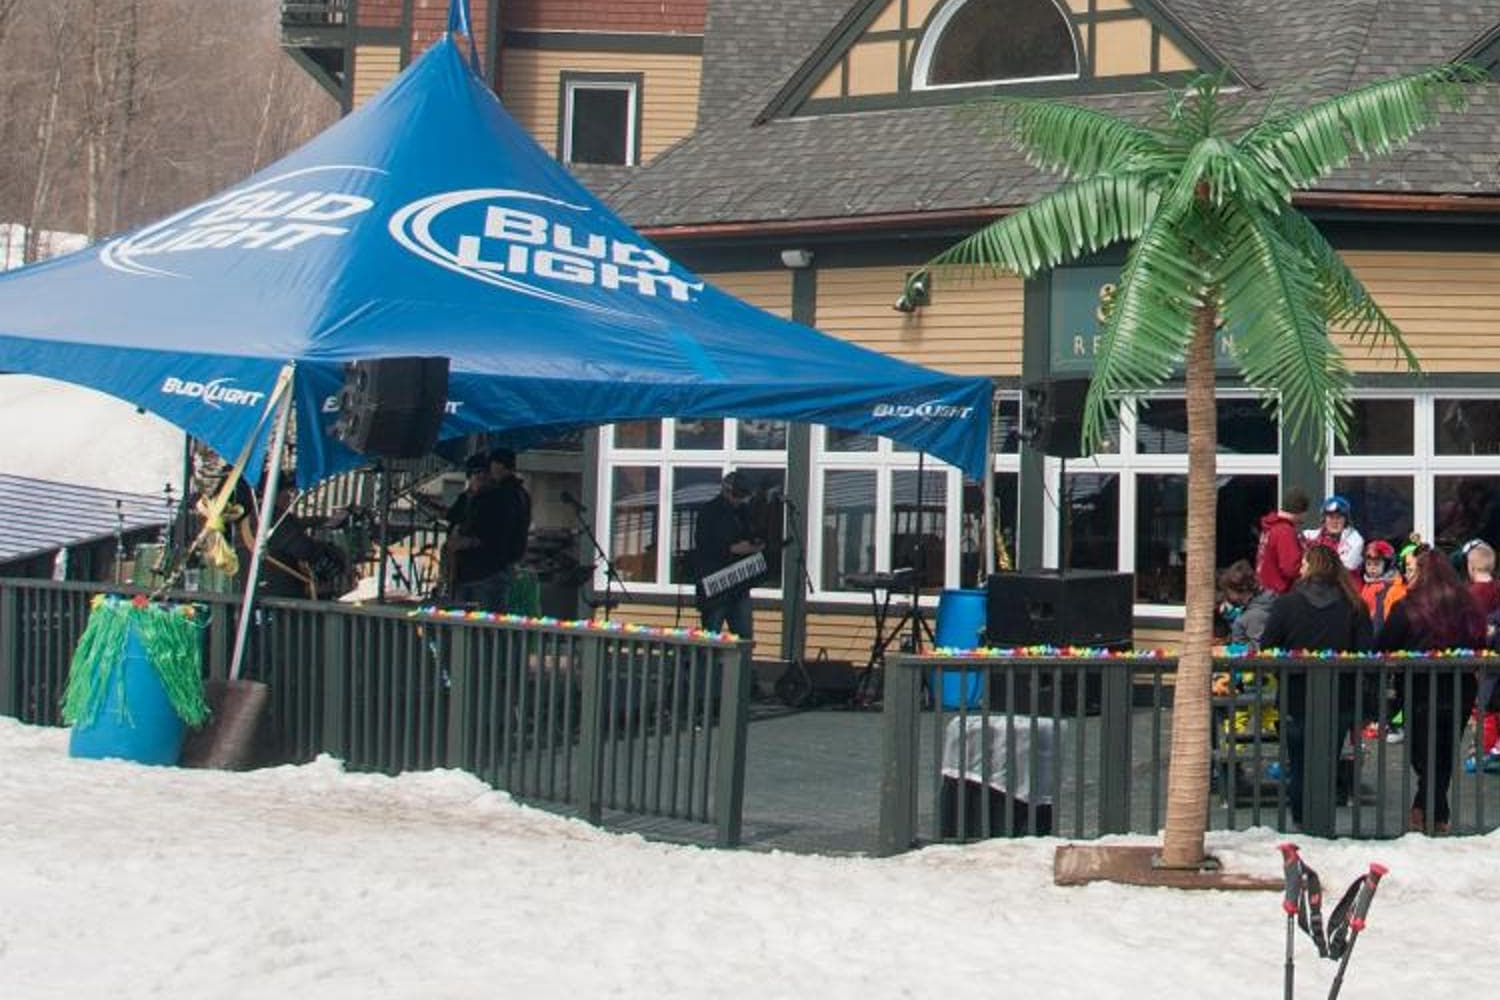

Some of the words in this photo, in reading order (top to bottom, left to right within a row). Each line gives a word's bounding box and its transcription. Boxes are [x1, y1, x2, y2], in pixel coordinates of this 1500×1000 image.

[456, 234, 704, 302] LIGHT
[484, 205, 670, 273] BUD
[161, 377, 203, 397] BUD
[206, 384, 265, 407] LIGHT
